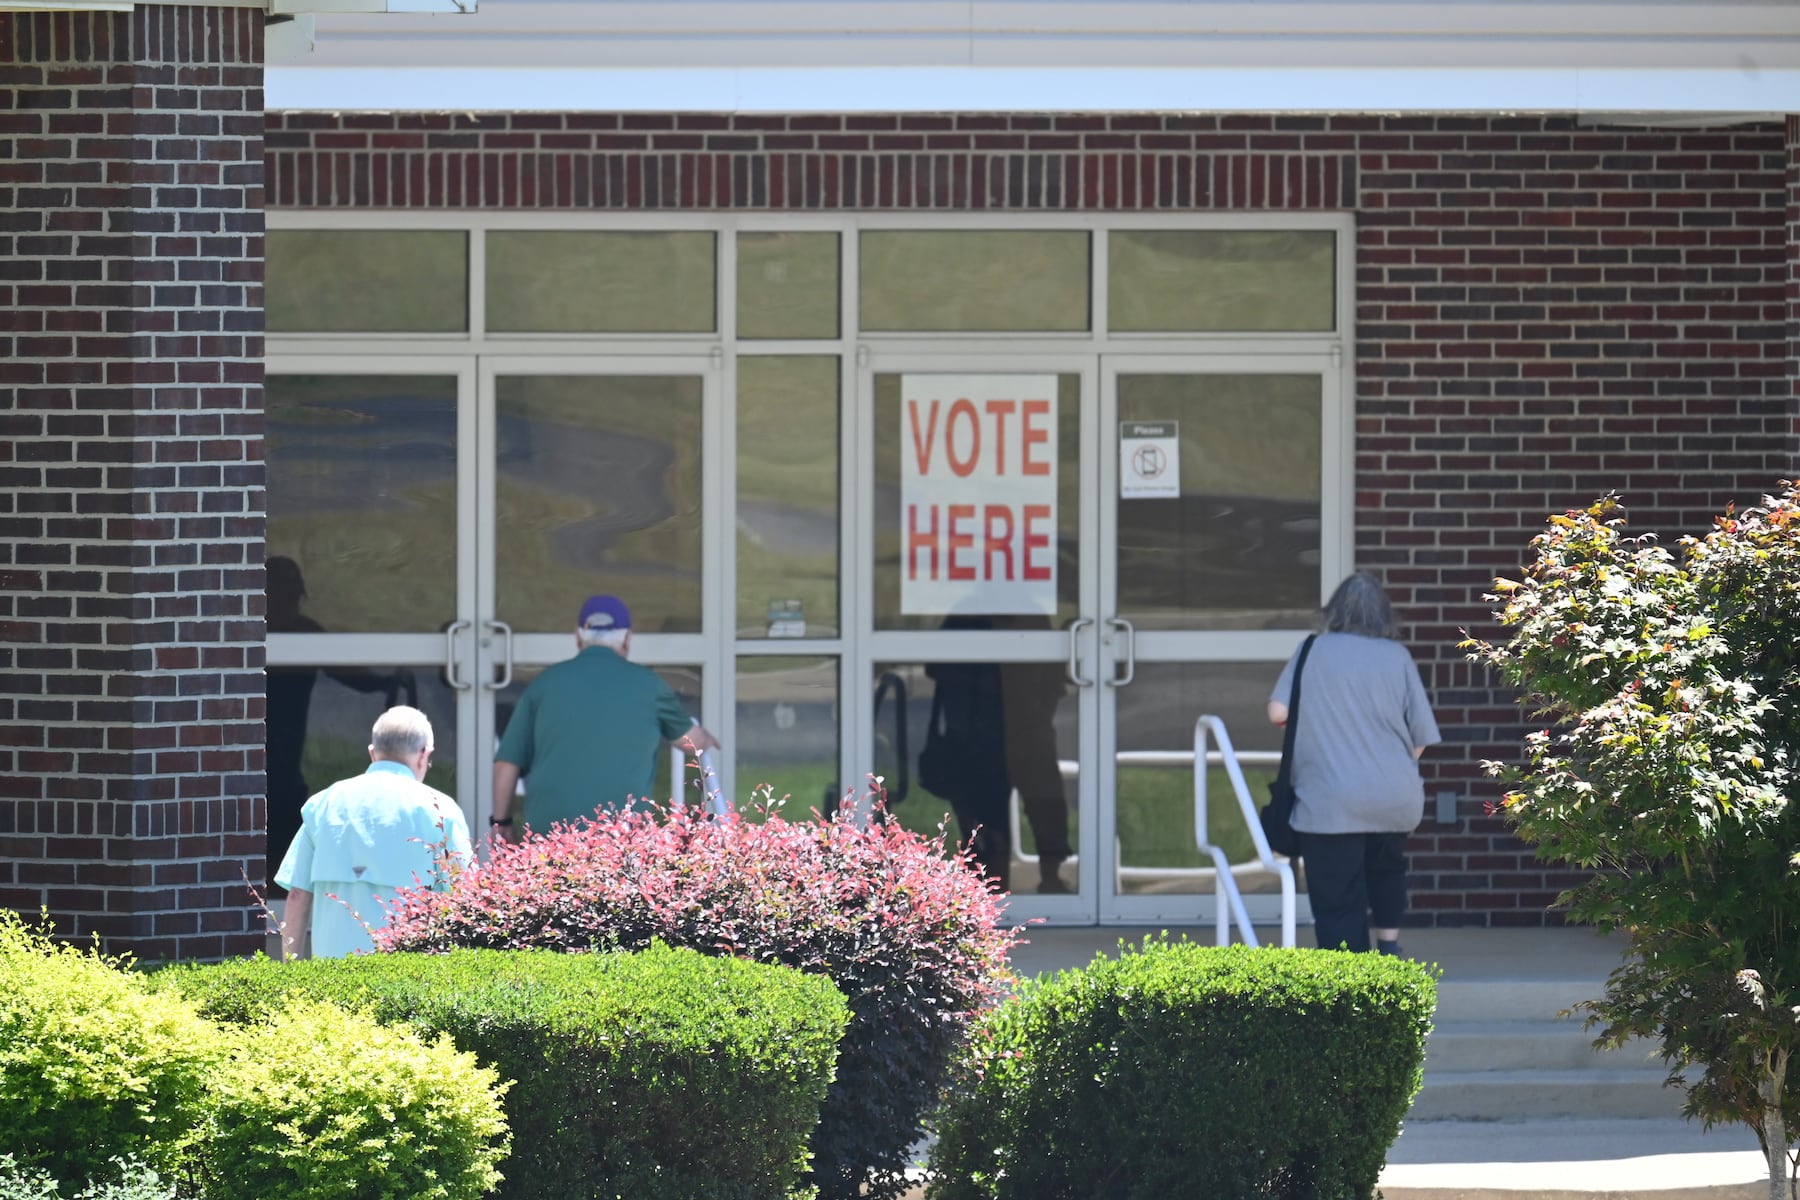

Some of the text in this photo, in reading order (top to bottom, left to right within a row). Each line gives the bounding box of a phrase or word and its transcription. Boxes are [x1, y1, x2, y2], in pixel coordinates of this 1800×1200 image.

[908, 399, 1051, 477] VOTE
[1134, 426, 1164, 435] Please
[908, 504, 1052, 581] HERE
